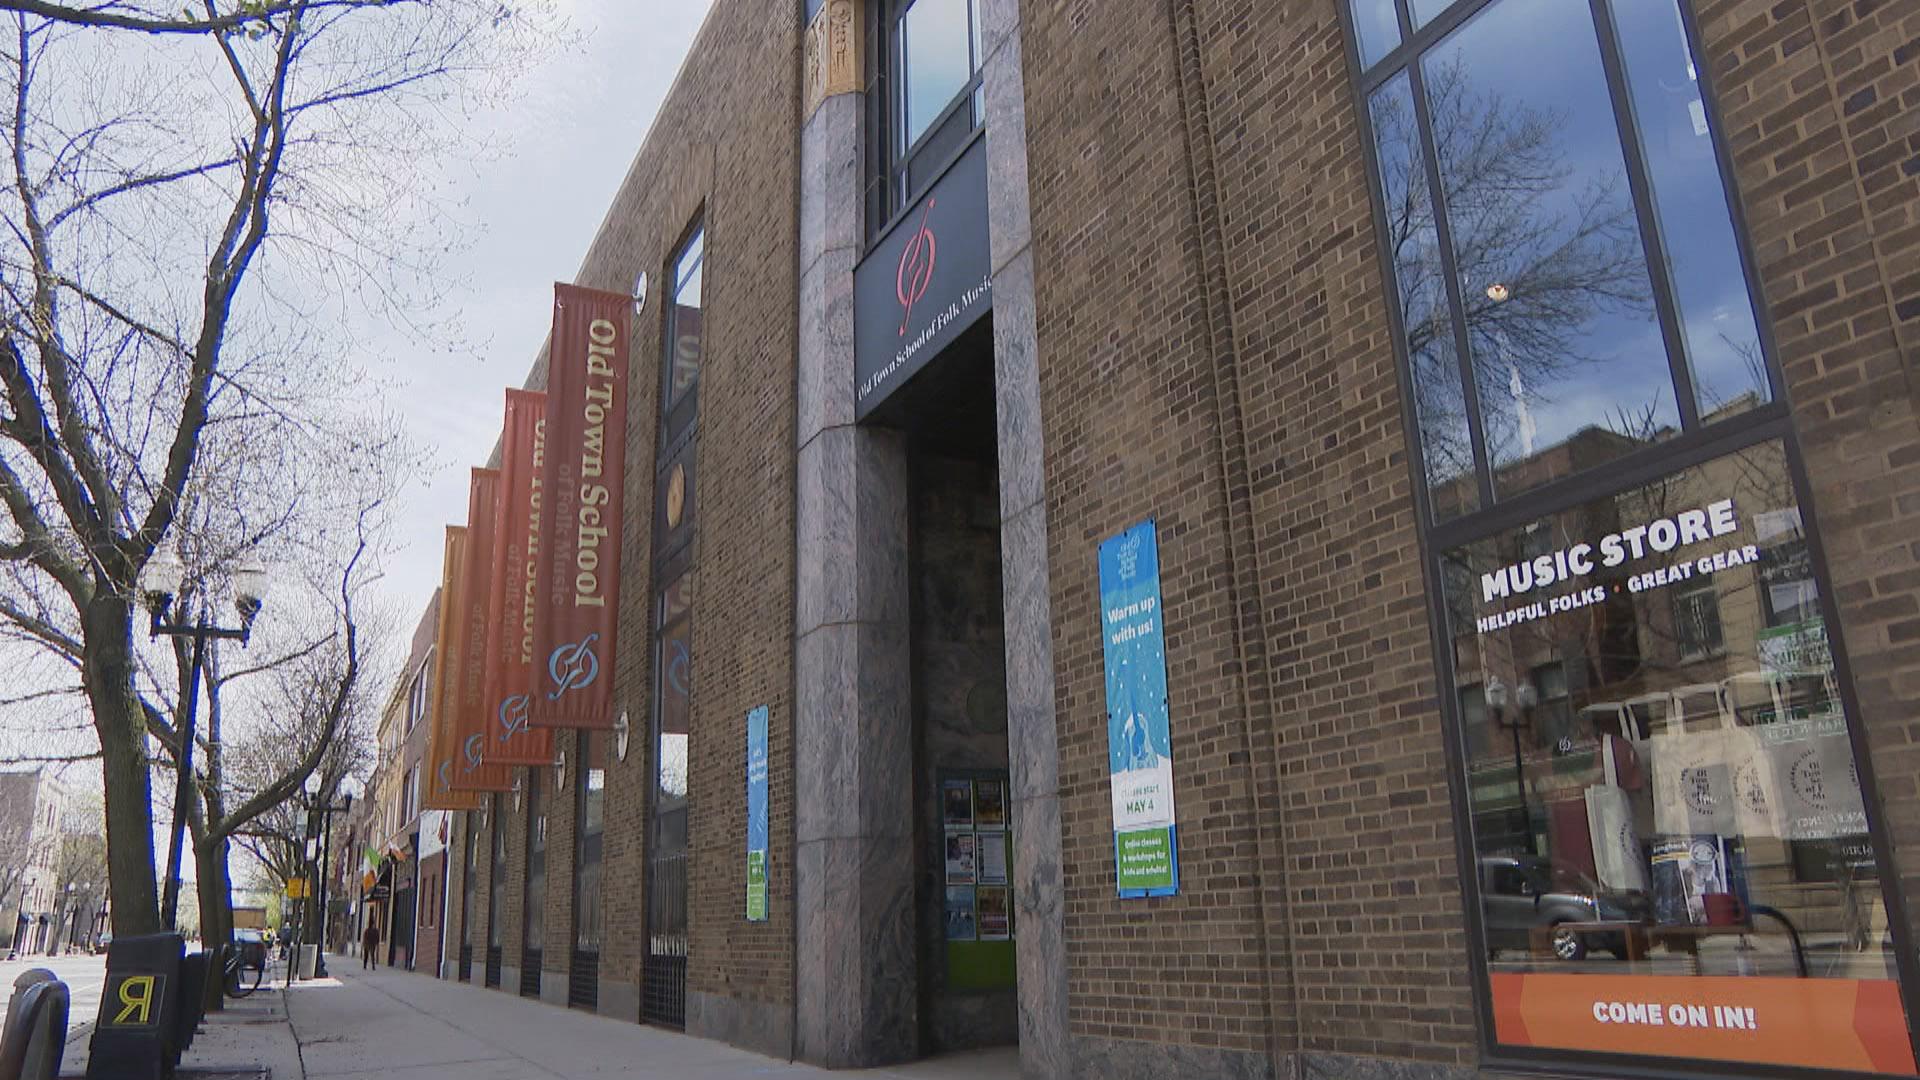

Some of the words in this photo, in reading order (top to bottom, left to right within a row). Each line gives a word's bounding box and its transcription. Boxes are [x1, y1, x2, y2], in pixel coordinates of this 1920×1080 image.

[587, 318, 616, 378] Old
[858, 378, 872, 401] Old
[872, 360, 895, 388] Town
[895, 329, 925, 367] School
[925, 319, 937, 340] of
[937, 302, 960, 331] Folk
[960, 274, 993, 311] Music
[582, 383, 613, 478] Town
[558, 463, 575, 488] of
[555, 487, 574, 537] Folk
[508, 544, 521, 561] of
[552, 537, 572, 607] Music
[575, 484, 609, 608] School
[1481, 543, 1594, 602] MUSIC
[1600, 498, 1738, 567] STORE
[505, 563, 520, 606] Folk
[1108, 602, 1139, 624] Warm
[1140, 596, 1155, 613] up
[1476, 603, 1547, 634] HELPFUL
[1549, 585, 1606, 615] FOLKS
[1627, 562, 1694, 593] GREAT
[1697, 545, 1760, 575] GEAR
[502, 607, 518, 664] Music
[1111, 623, 1136, 645] with
[1137, 617, 1154, 636] us!
[1126, 800, 1146, 815] MAY
[1147, 799, 1154, 811] 4
[1593, 1001, 1664, 1026] COME
[1668, 1004, 1709, 1028] ON
[1713, 1005, 1757, 1030] IN!
